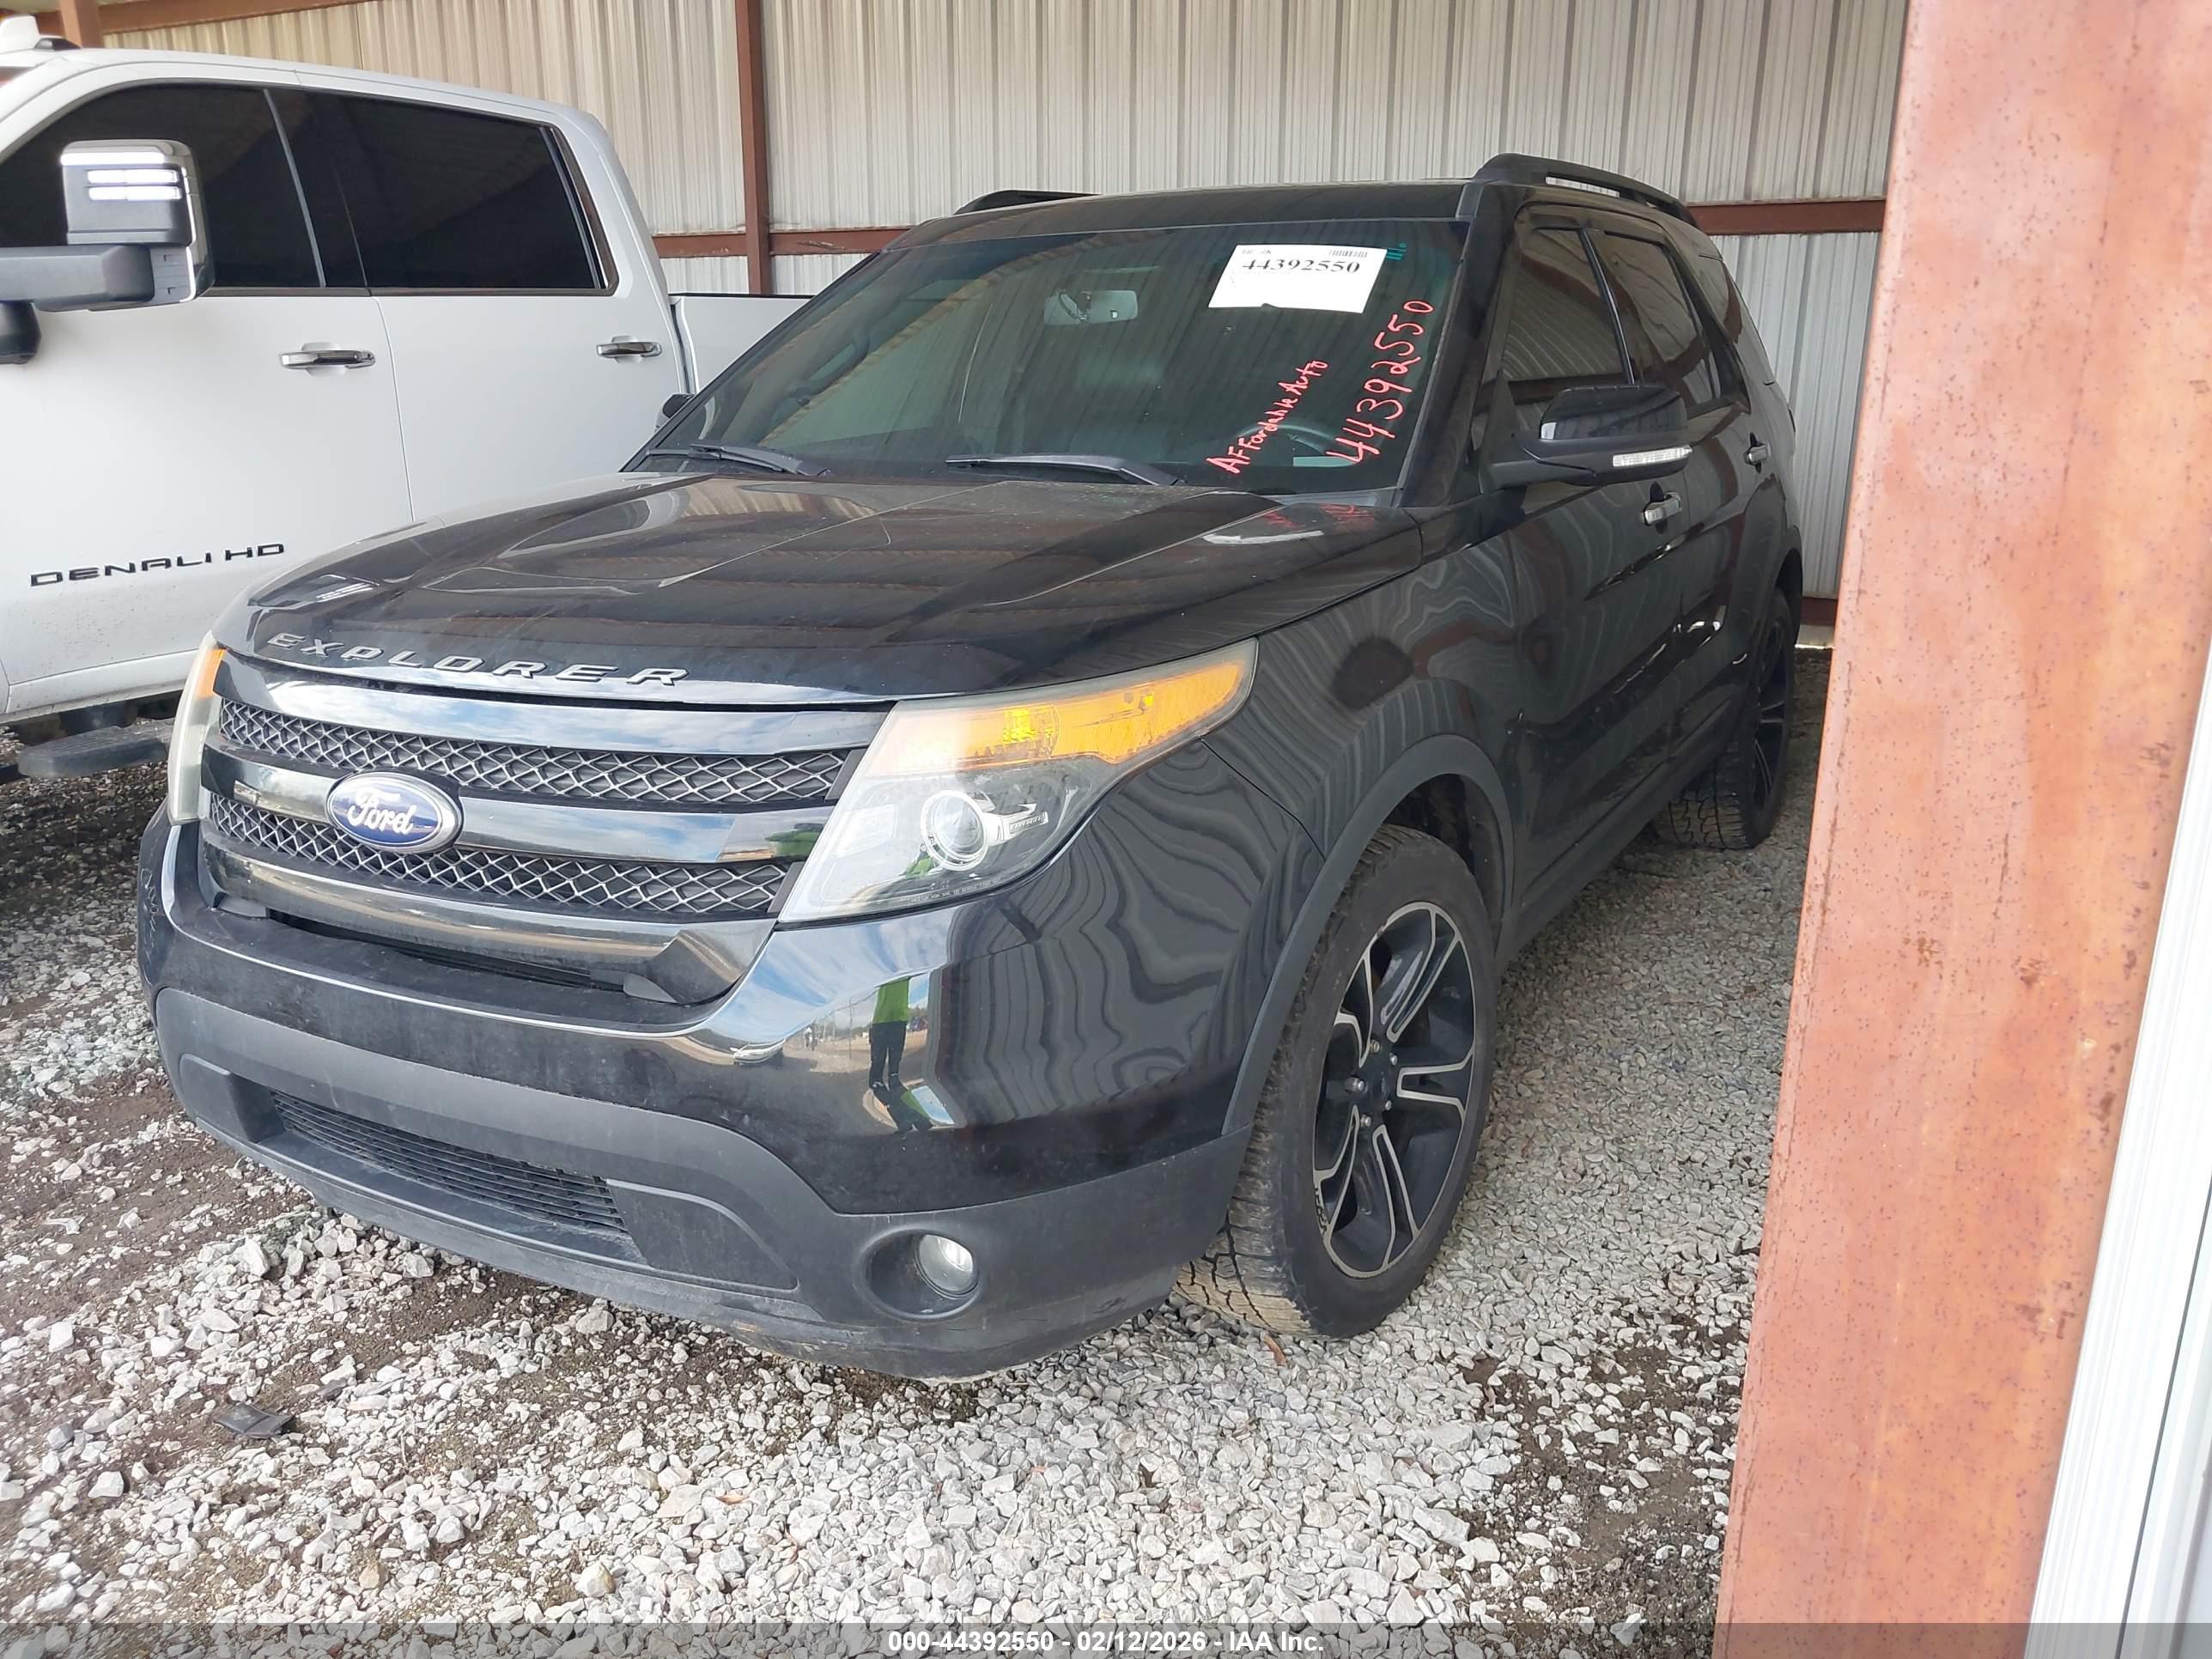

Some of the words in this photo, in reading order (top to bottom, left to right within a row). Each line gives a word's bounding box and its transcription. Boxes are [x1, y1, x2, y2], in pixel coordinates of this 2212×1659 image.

[1243, 258, 1360, 273] 44392550
[1326, 301, 1434, 464] 44392550
[30, 552, 213, 586] DENALI
[224, 543, 285, 561] HD
[266, 632, 690, 686] EXPLORER
[347, 788, 417, 835] Ford
